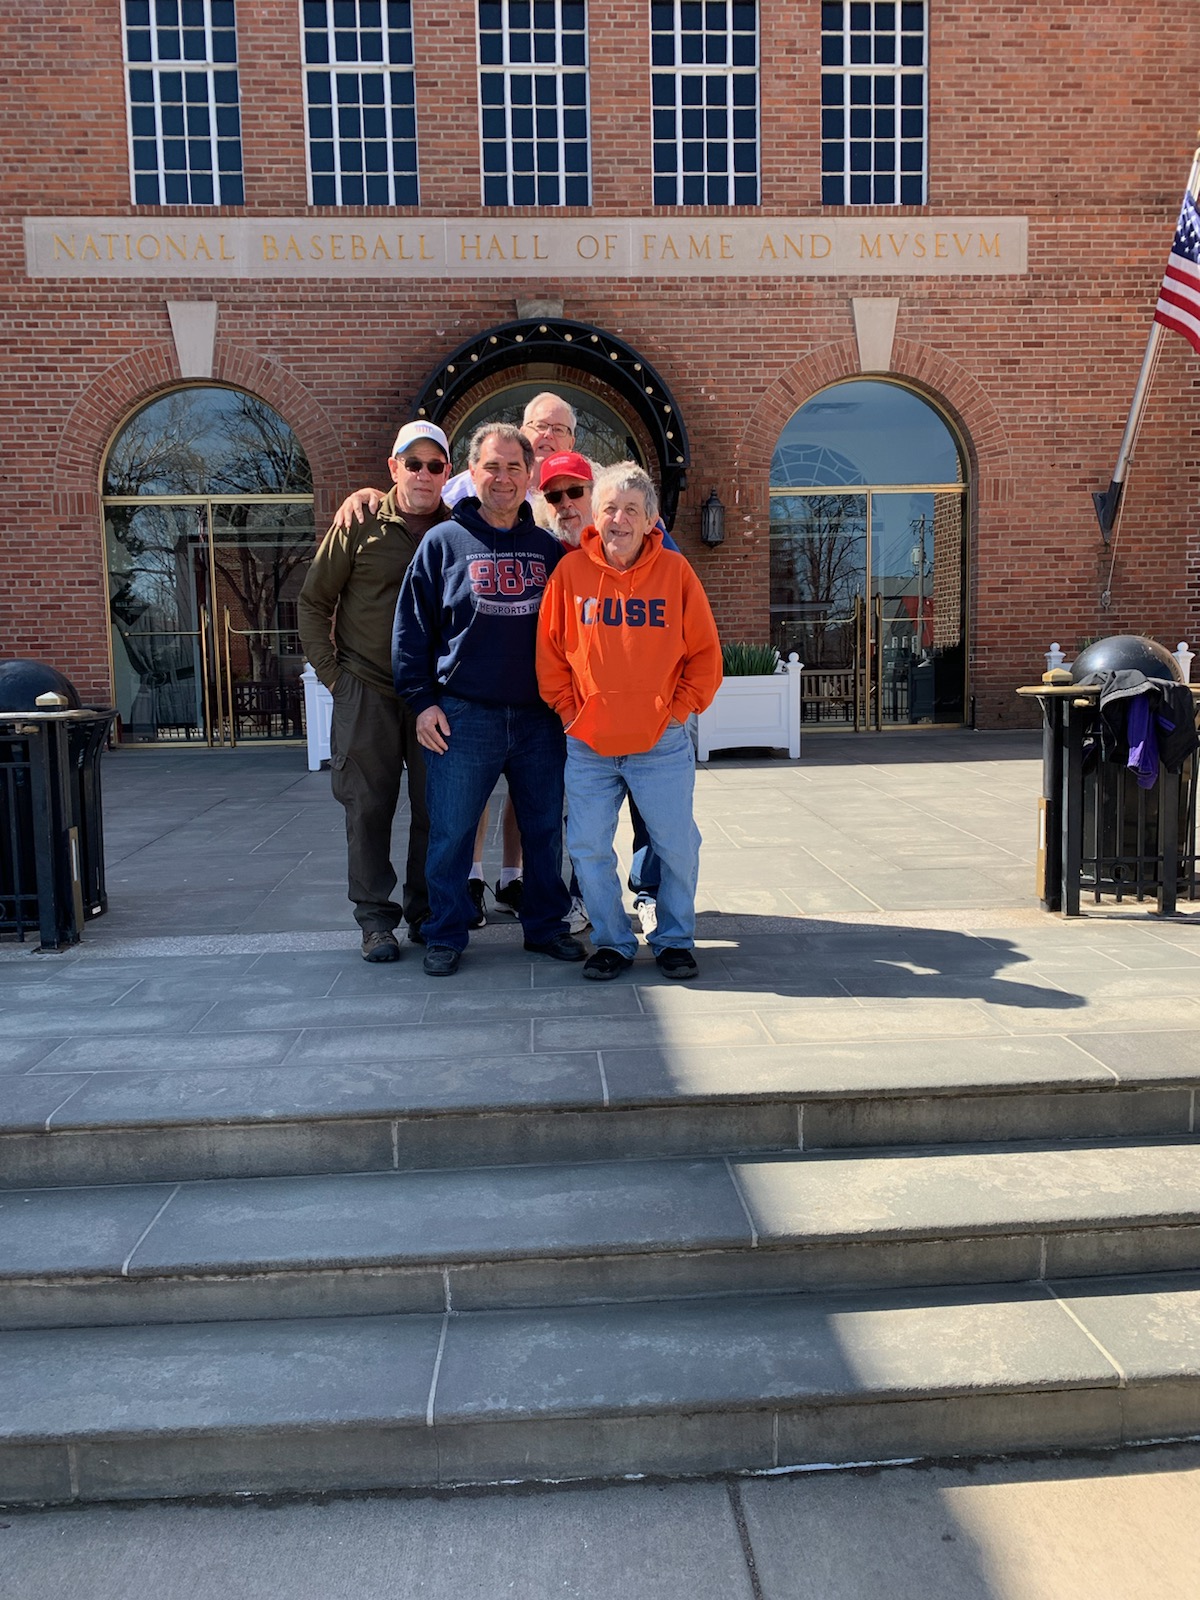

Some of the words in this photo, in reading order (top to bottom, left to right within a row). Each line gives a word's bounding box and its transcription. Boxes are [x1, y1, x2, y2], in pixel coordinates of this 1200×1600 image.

[53, 234, 235, 260] NATIONAL
[261, 234, 435, 260] BASEBALL
[459, 234, 549, 260] HALL
[576, 234, 618, 260] OF
[642, 234, 735, 260] FAME
[758, 233, 832, 259] AND
[859, 233, 1001, 258] MVSEVM
[526, 552, 545, 561] SPORTS
[468, 559, 548, 595] 98.5
[493, 605, 527, 614] SPORTS
